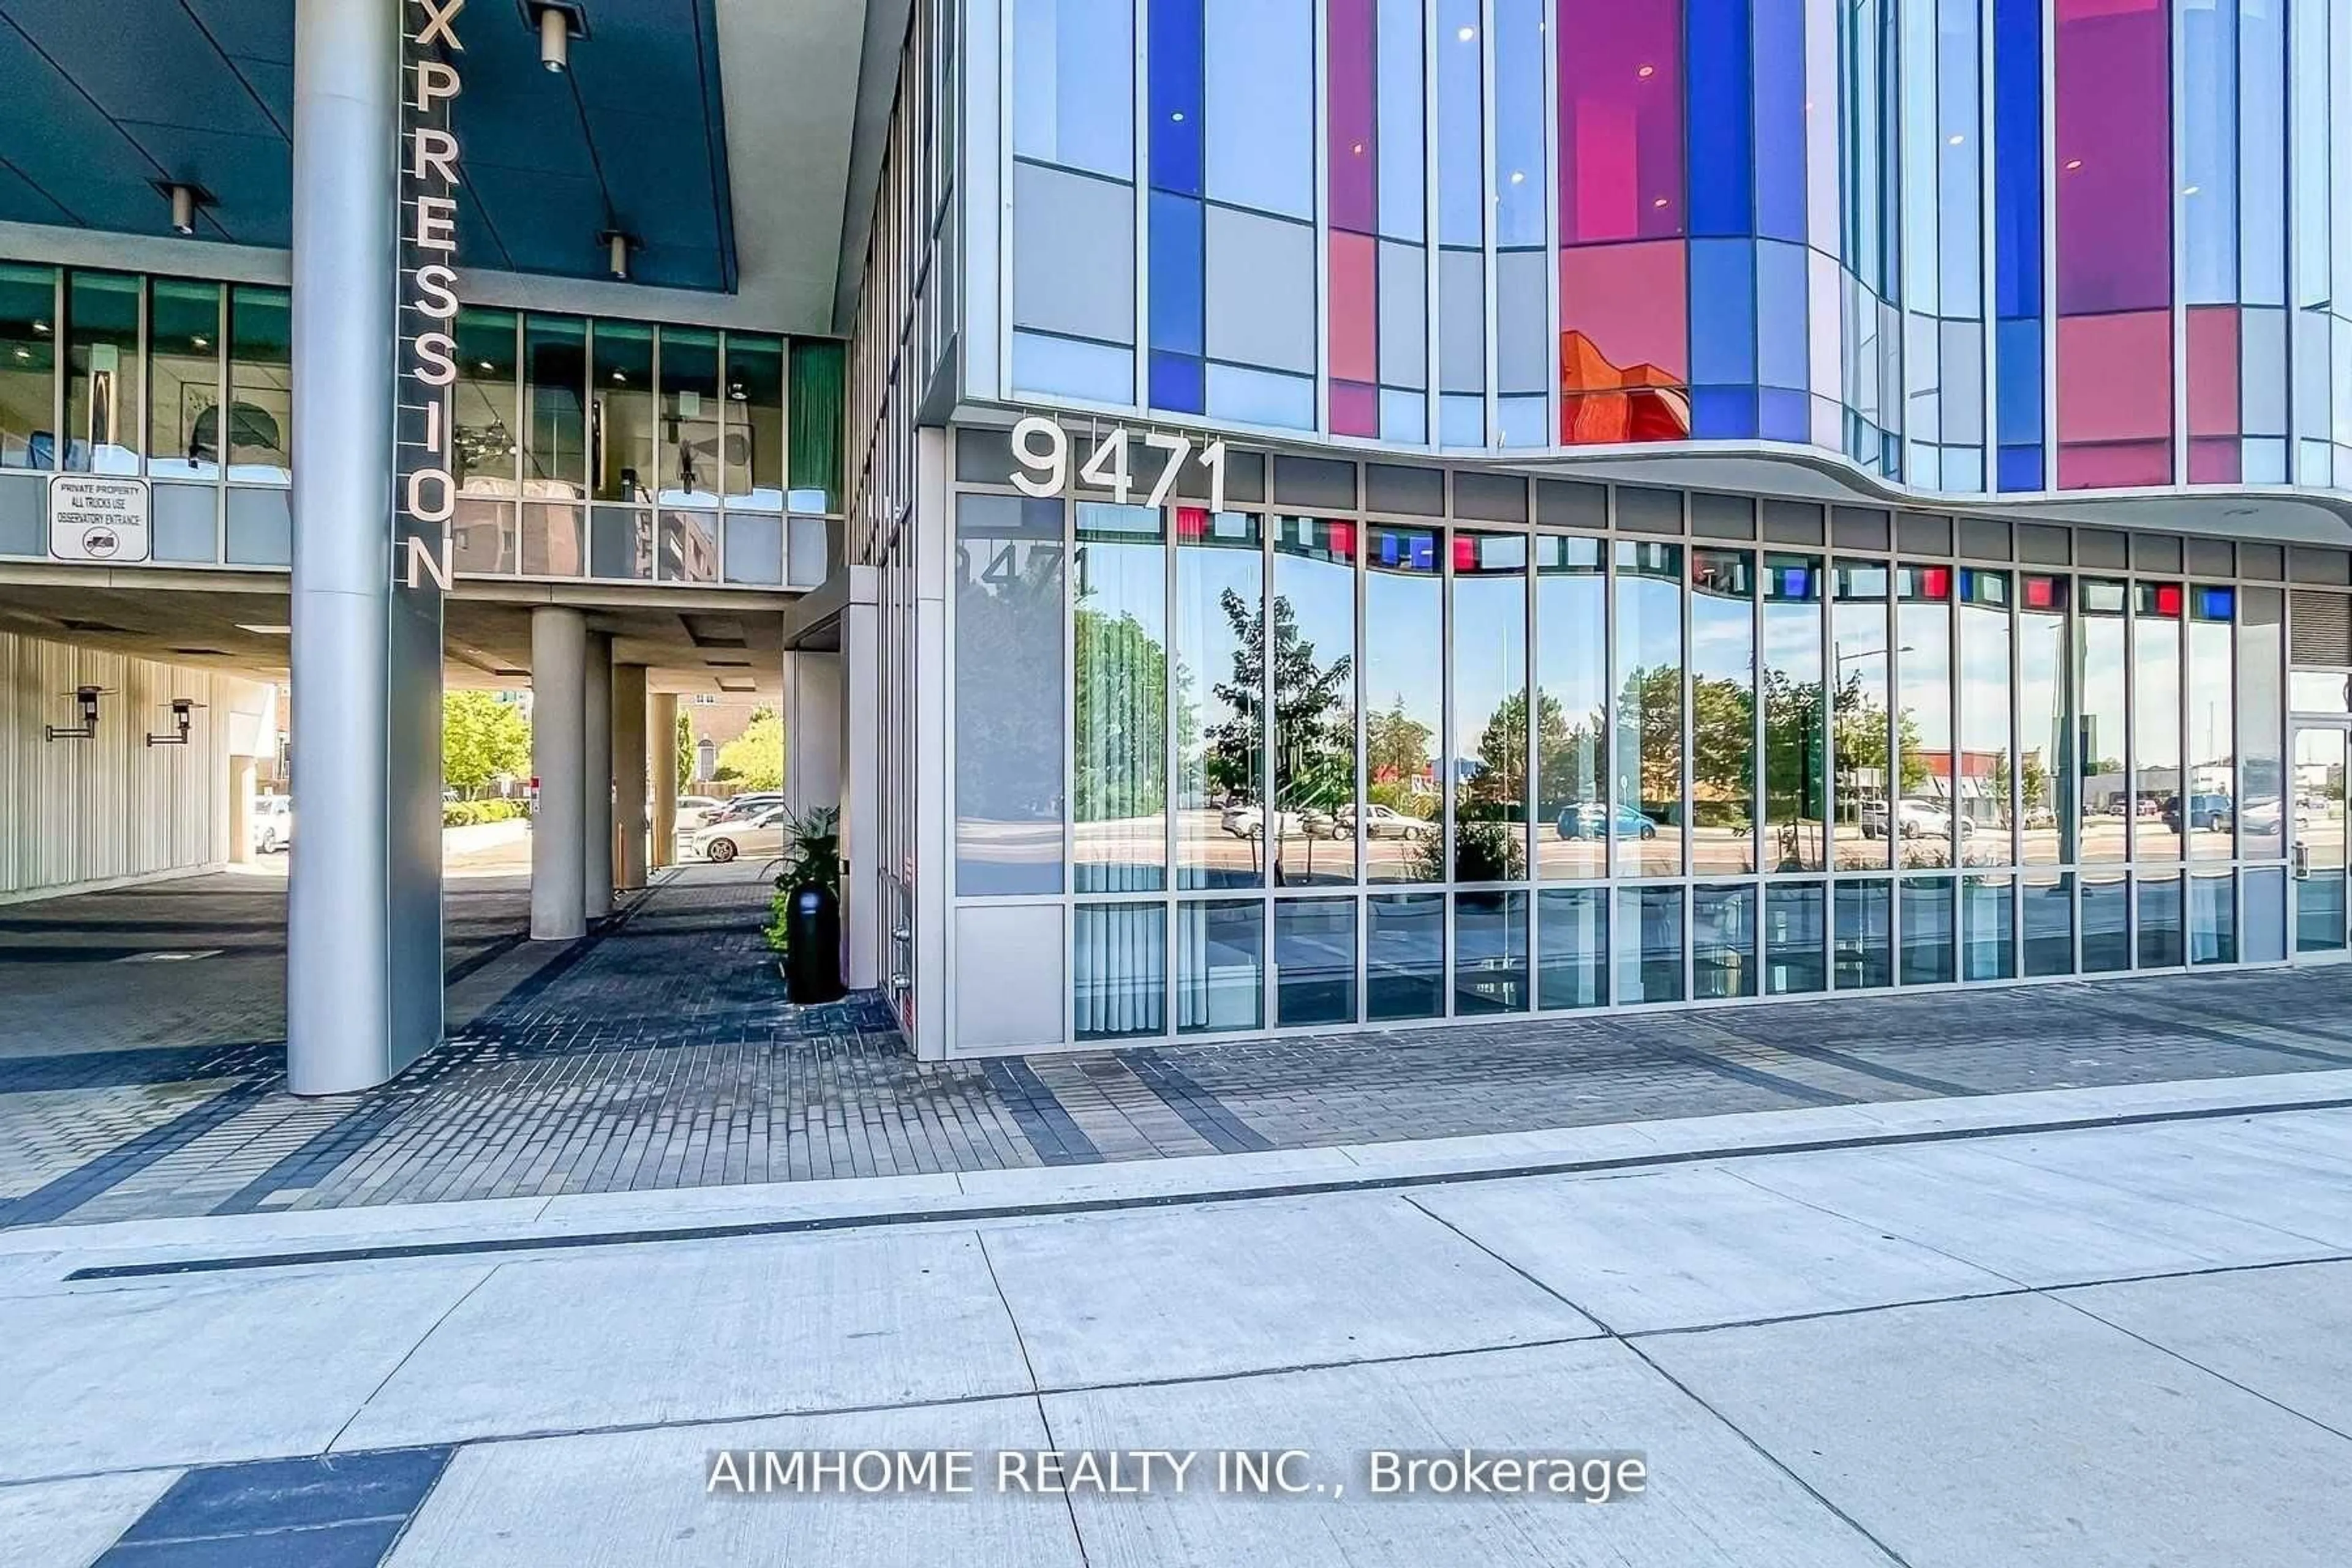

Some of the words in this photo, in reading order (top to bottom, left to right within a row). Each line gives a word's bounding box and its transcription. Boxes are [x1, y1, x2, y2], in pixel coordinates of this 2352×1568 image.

[407, 0, 466, 592] XPRESSION
[1009, 417, 1226, 514] 9471
[61, 484, 94, 494] PRIVATE
[96, 486, 139, 496] PROPERTY
[72, 497, 85, 508] ALL
[85, 497, 111, 508] TRUCKS
[112, 499, 126, 509] USE
[58, 512, 104, 524] OBSERVATORY
[105, 514, 140, 526] ENTRANCE
